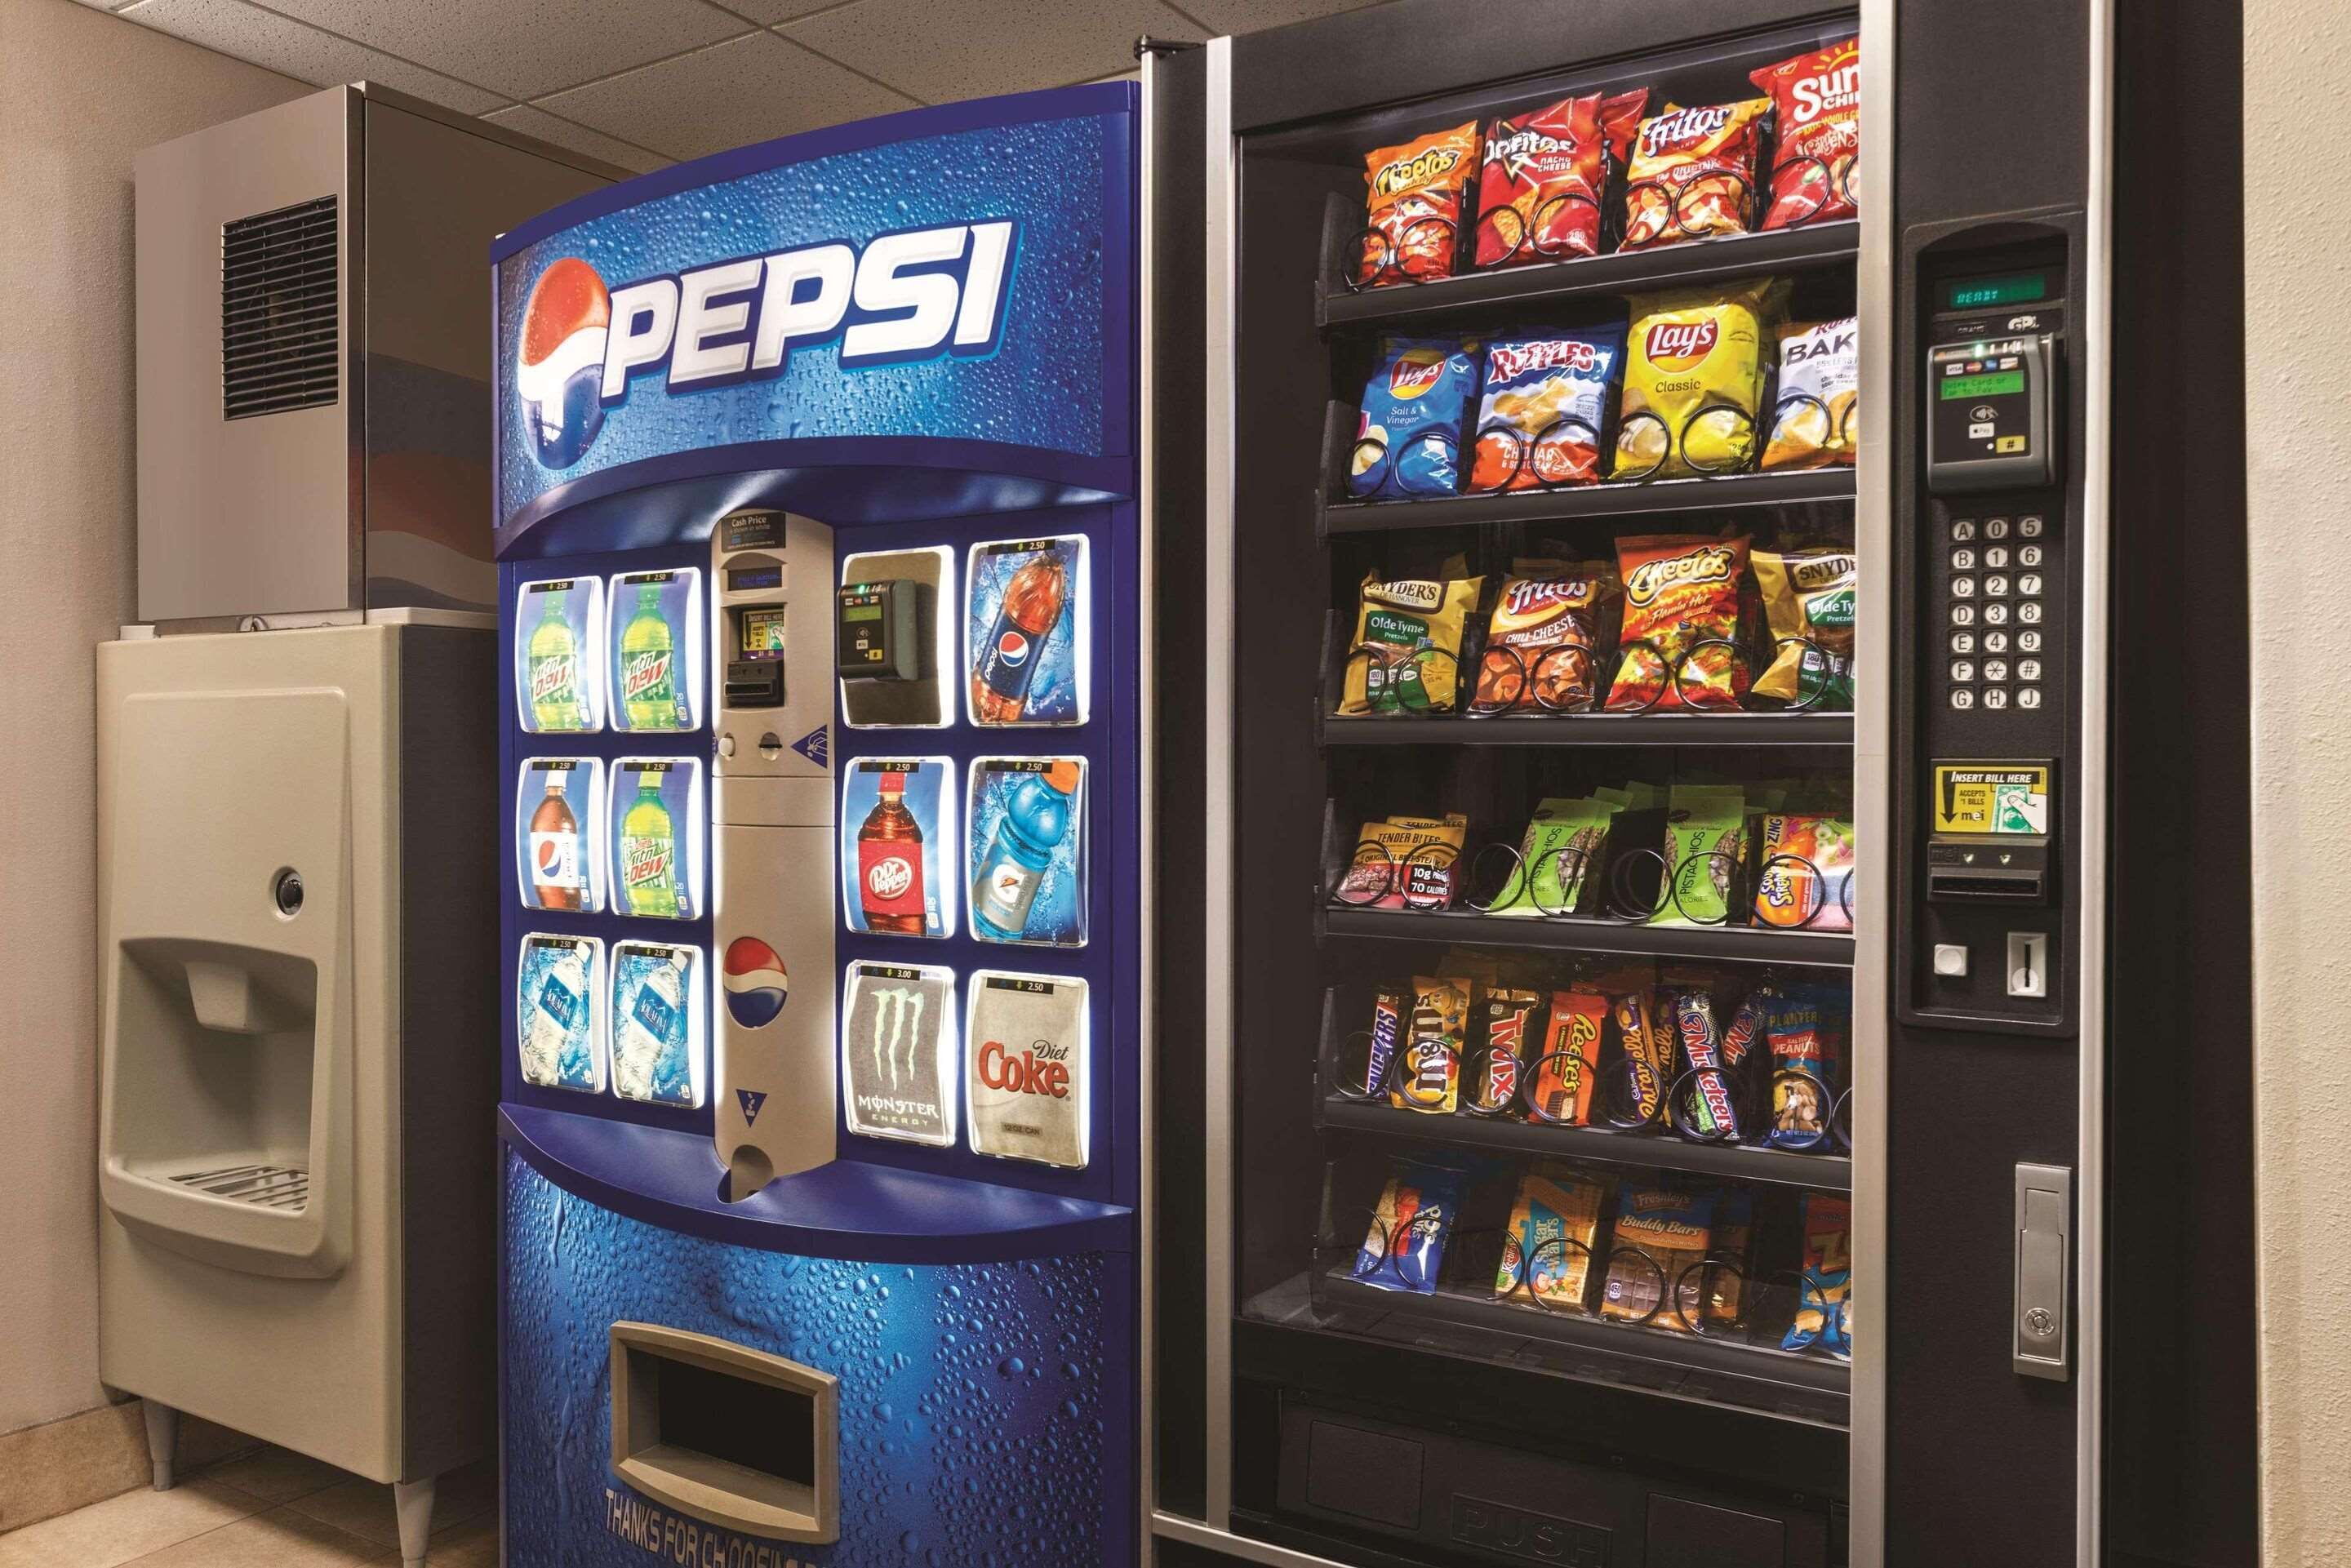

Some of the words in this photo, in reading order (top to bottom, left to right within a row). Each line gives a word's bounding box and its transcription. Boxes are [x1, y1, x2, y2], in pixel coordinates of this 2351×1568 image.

[1793, 64, 1860, 122] Sun
[1643, 109, 1731, 156] Fritos
[1538, 162, 1571, 171] CHEESE
[1540, 157, 1571, 165] NACHO
[601, 222, 1012, 398] PEPSI
[1650, 322, 1713, 358] Lay's
[1786, 331, 1857, 366] BAK
[1488, 341, 1595, 385] RUFFLES
[1655, 379, 1701, 393] Classic
[1391, 406, 1409, 415] Salt
[1386, 416, 1419, 426] Vinegar
[731, 517, 747, 527] Cash
[748, 515, 767, 524] Price
[2026, 520, 2035, 534] 5
[1958, 524, 1968, 538] A
[1992, 522, 2000, 536] 0
[1029, 541, 1045, 550] 2.50
[1959, 553, 1968, 566] B
[1993, 551, 1998, 564] 1
[2026, 549, 2035, 562] 6
[654, 573, 666, 581] 2.50
[2026, 577, 2034, 591] 7
[557, 582, 568, 590] 2.50
[1958, 580, 1967, 593] C
[1992, 578, 2000, 593] 2
[1689, 594, 1709, 607] Hot
[1958, 608, 1967, 621] D
[1991, 606, 2000, 620] 3
[2025, 605, 2033, 620] 8
[1371, 617, 1398, 629] Olde
[1398, 621, 1424, 634] Tyme
[1384, 632, 1408, 641] Pretzels
[1958, 635, 1967, 650] E
[1991, 634, 2000, 648] 4
[2025, 633, 2033, 647] 9
[985, 646, 998, 681] pepsi
[1807, 653, 1820, 662] 180
[1958, 664, 1967, 678] F
[1958, 691, 1967, 705] G
[1990, 691, 1999, 705] H
[2024, 691, 2033, 704] J
[896, 763, 910, 771] 2.50
[1026, 763, 1042, 771] 2.50
[2007, 775, 2032, 783] HERE
[1962, 810, 1984, 821] mei
[1378, 833, 1411, 843] TENDER
[1412, 833, 1441, 843] BITES
[883, 862, 899, 877] Dr
[1680, 831, 1704, 895] PISTACHIOS
[871, 866, 909, 895] Pepper
[1414, 868, 1431, 880] 10g
[1411, 882, 1424, 892] 70
[897, 970, 911, 979] 3.00
[1029, 982, 1043, 992] 2.50
[1680, 1014, 1703, 1035] 3
[1033, 1040, 1069, 1060] Diet
[1562, 1013, 1597, 1091] Reese's
[1774, 1042, 1820, 1055] PEANUTS
[1490, 1010, 1523, 1102] TWIX
[980, 1042, 1069, 1099] Coke
[1684, 1032, 1733, 1132] Musketeers
[858, 1095, 939, 1117] MONSTER
[872, 1115, 928, 1126] ENERGY
[1024, 1126, 1040, 1135] CAN
[1622, 1215, 1665, 1235] Buddy
[1669, 1221, 1700, 1236] Bars
[1535, 1219, 1549, 1264] Sugar
[1611, 1285, 1620, 1294] 450
[606, 1489, 660, 1552] THANKS
[664, 1517, 697, 1568] FOR
